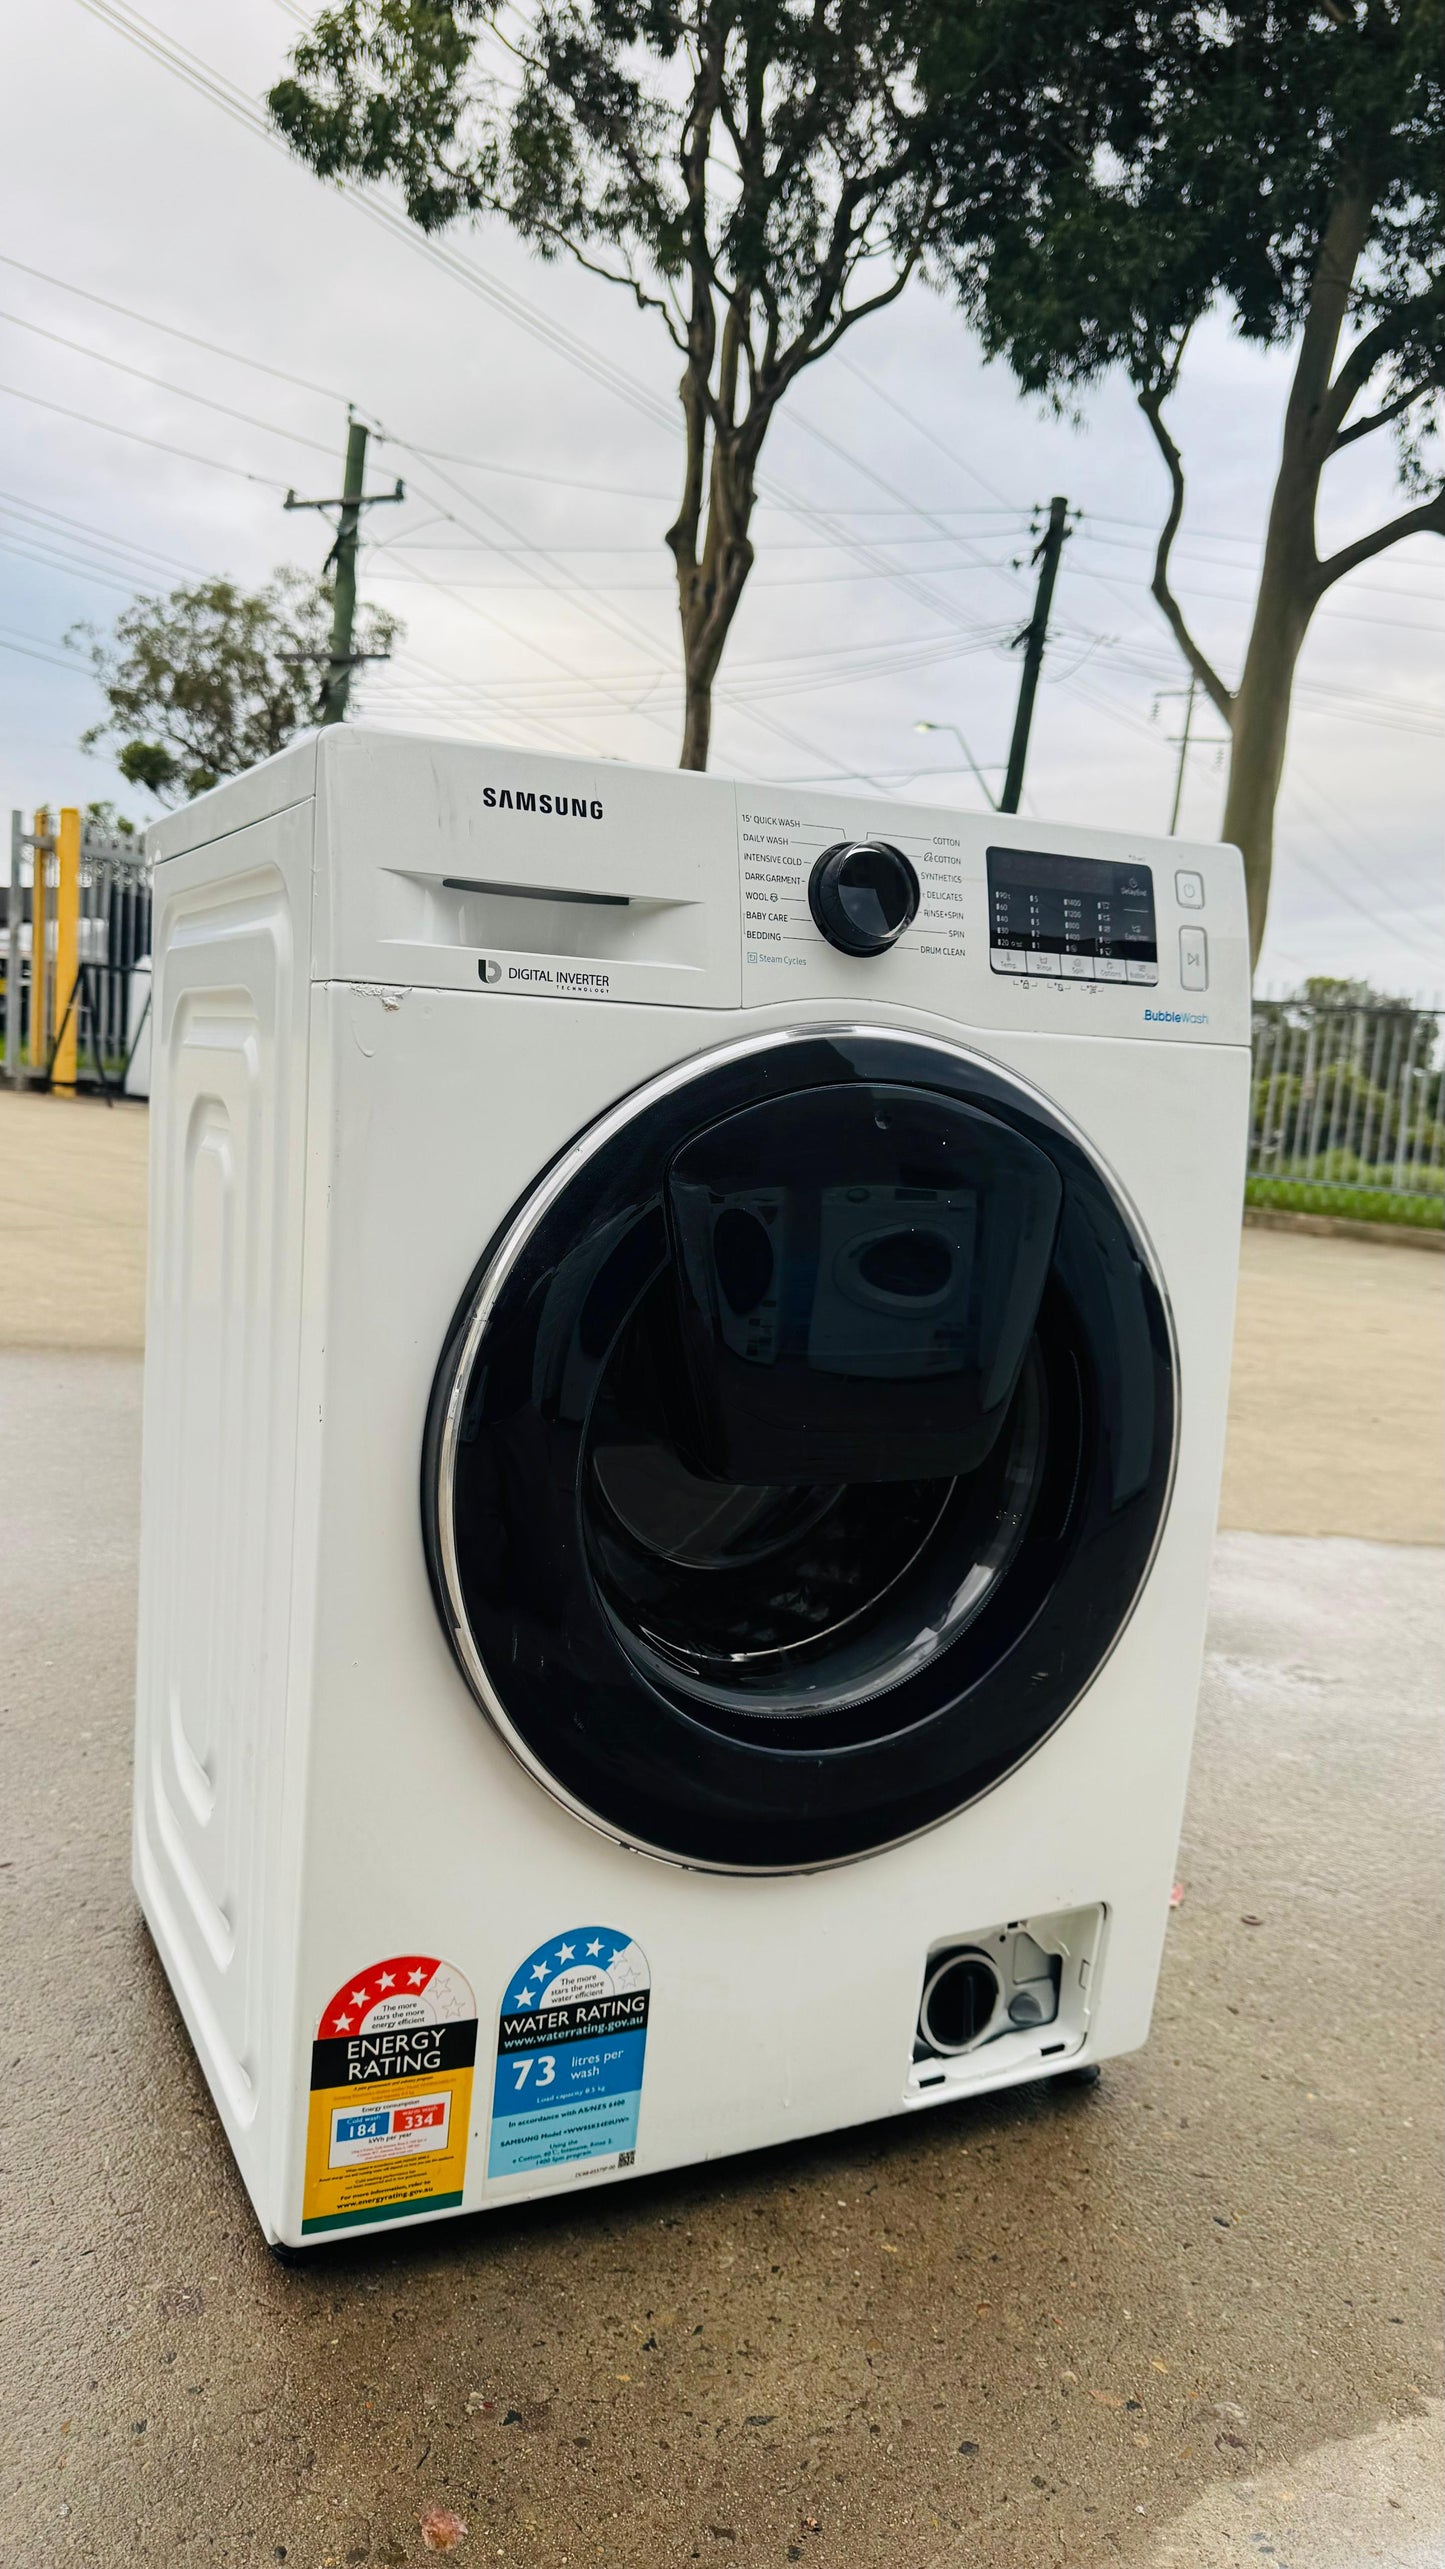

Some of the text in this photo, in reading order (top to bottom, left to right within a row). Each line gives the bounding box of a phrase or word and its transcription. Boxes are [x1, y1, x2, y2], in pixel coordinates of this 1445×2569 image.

[482, 788, 603, 820] SAMSUNG
[753, 816, 777, 825] QUICK
[778, 818, 800, 827] WASH
[743, 834, 789, 845] DAILY WASH
[933, 837, 960, 846] COTTON
[744, 853, 802, 866] INTENSIVE COLD
[934, 855, 961, 865] COTTON
[745, 872, 800, 885] DARK GARMENT
[921, 872, 962, 883] SYNTHETICS
[745, 892, 769, 901] WOOL
[926, 891, 963, 901] DELICATES
[746, 911, 788, 922] BABY CARE
[923, 910, 964, 920] RINSE+SPIN
[746, 930, 781, 941] BEDDING
[948, 930, 965, 939] SPIN
[920, 946, 966, 957] DRUM CLEAN
[759, 954, 807, 966] Steam Cycles
[508, 967, 610, 987] DIGITAL INVERTER
[556, 984, 610, 994] TECHNOLOGY
[1144, 1009, 1208, 1025] BubbleWash
[551, 1988, 568, 1996] stars
[585, 1981, 604, 1989] more
[552, 1989, 602, 2003] water efficient
[503, 1996, 645, 2036] WATER RATING
[372, 2017, 424, 2029] energy efficient
[503, 2015, 644, 2049] www.waterrating.gov.au
[346, 2028, 446, 2060] ENERGY
[348, 2051, 441, 2082] RATING
[512, 2049, 624, 2091] 73 litres per
[570, 2067, 599, 2080] wash
[383, 2100, 419, 2110] consumption
[422, 2105, 438, 2113] wash
[347, 2117, 363, 2125] Cold
[405, 2112, 433, 2129] 334
[518, 2113, 559, 2126] accordance
[561, 2110, 577, 2118] with
[350, 2122, 376, 2138] 184
[369, 2136, 385, 2144] kWh
[398, 2132, 412, 2140] year
[501, 2135, 539, 2147] SAMSUNG
[541, 2130, 562, 2139] Model
[337, 2187, 433, 2209] www.energyrating.gov.au
[353, 2192, 369, 2200] more
